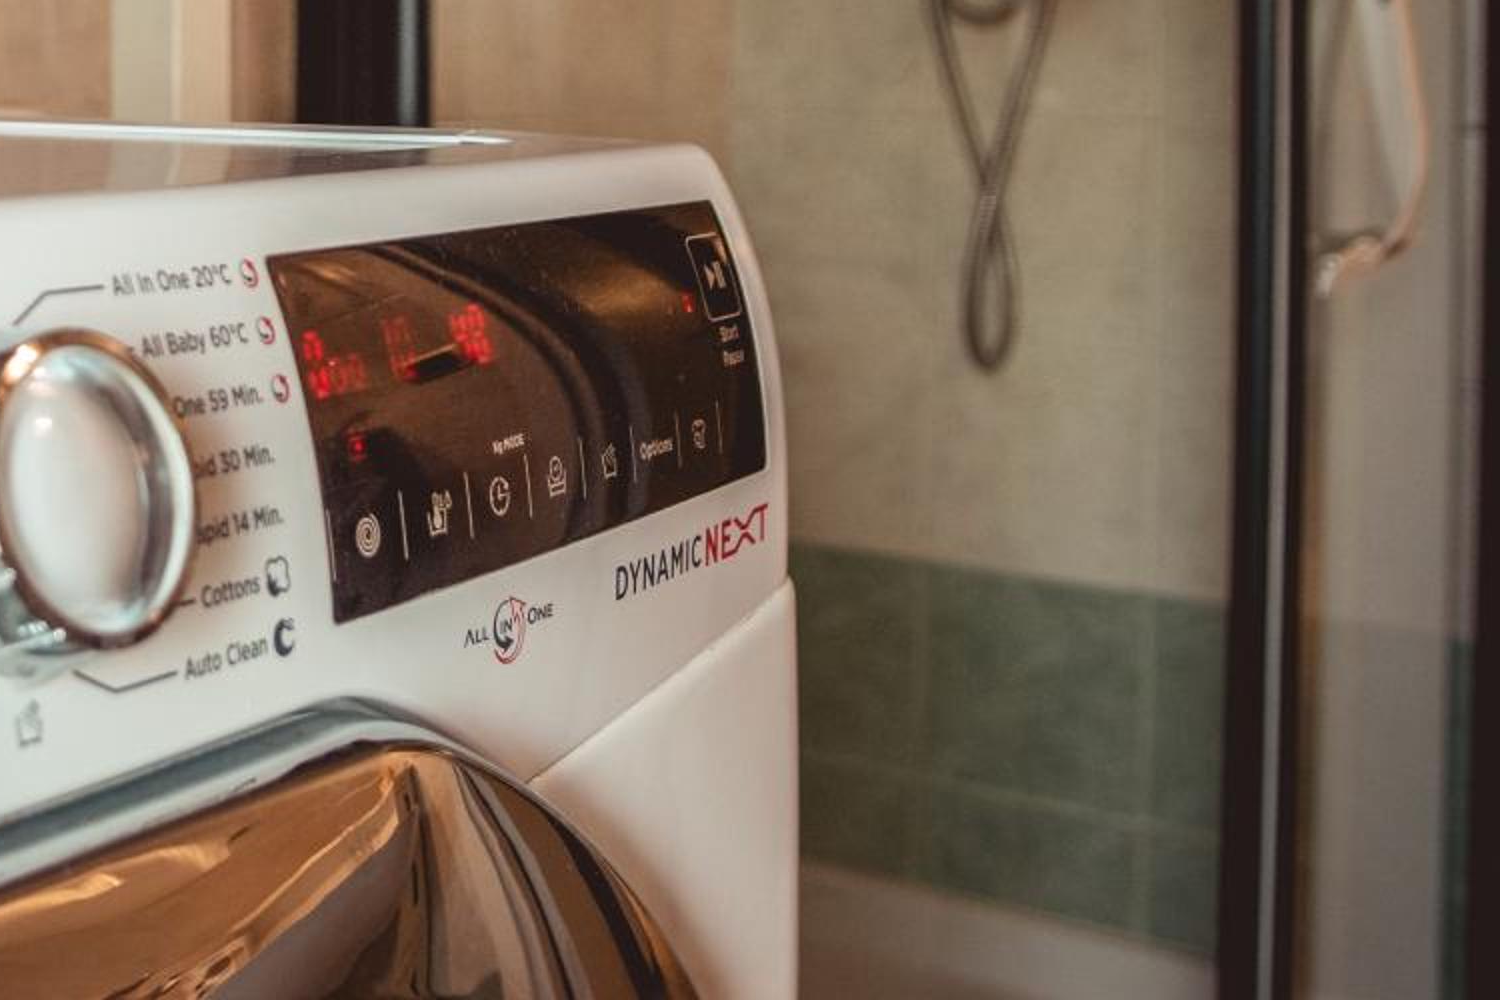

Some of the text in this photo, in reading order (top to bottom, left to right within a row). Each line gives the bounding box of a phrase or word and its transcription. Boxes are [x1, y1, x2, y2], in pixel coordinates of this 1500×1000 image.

[112, 264, 232, 296] All In One 20°C
[141, 322, 249, 357] All Baby 60°C
[172, 385, 264, 418] One 59 Min.
[219, 449, 241, 474] 30
[243, 445, 276, 468] Min.
[639, 437, 674, 460] Options
[232, 509, 250, 536] 14
[252, 504, 284, 530] Min.
[201, 576, 261, 608] Cottons
[464, 627, 489, 648] ALL
[527, 603, 553, 625] ONE
[184, 637, 269, 680] Auto Clean
